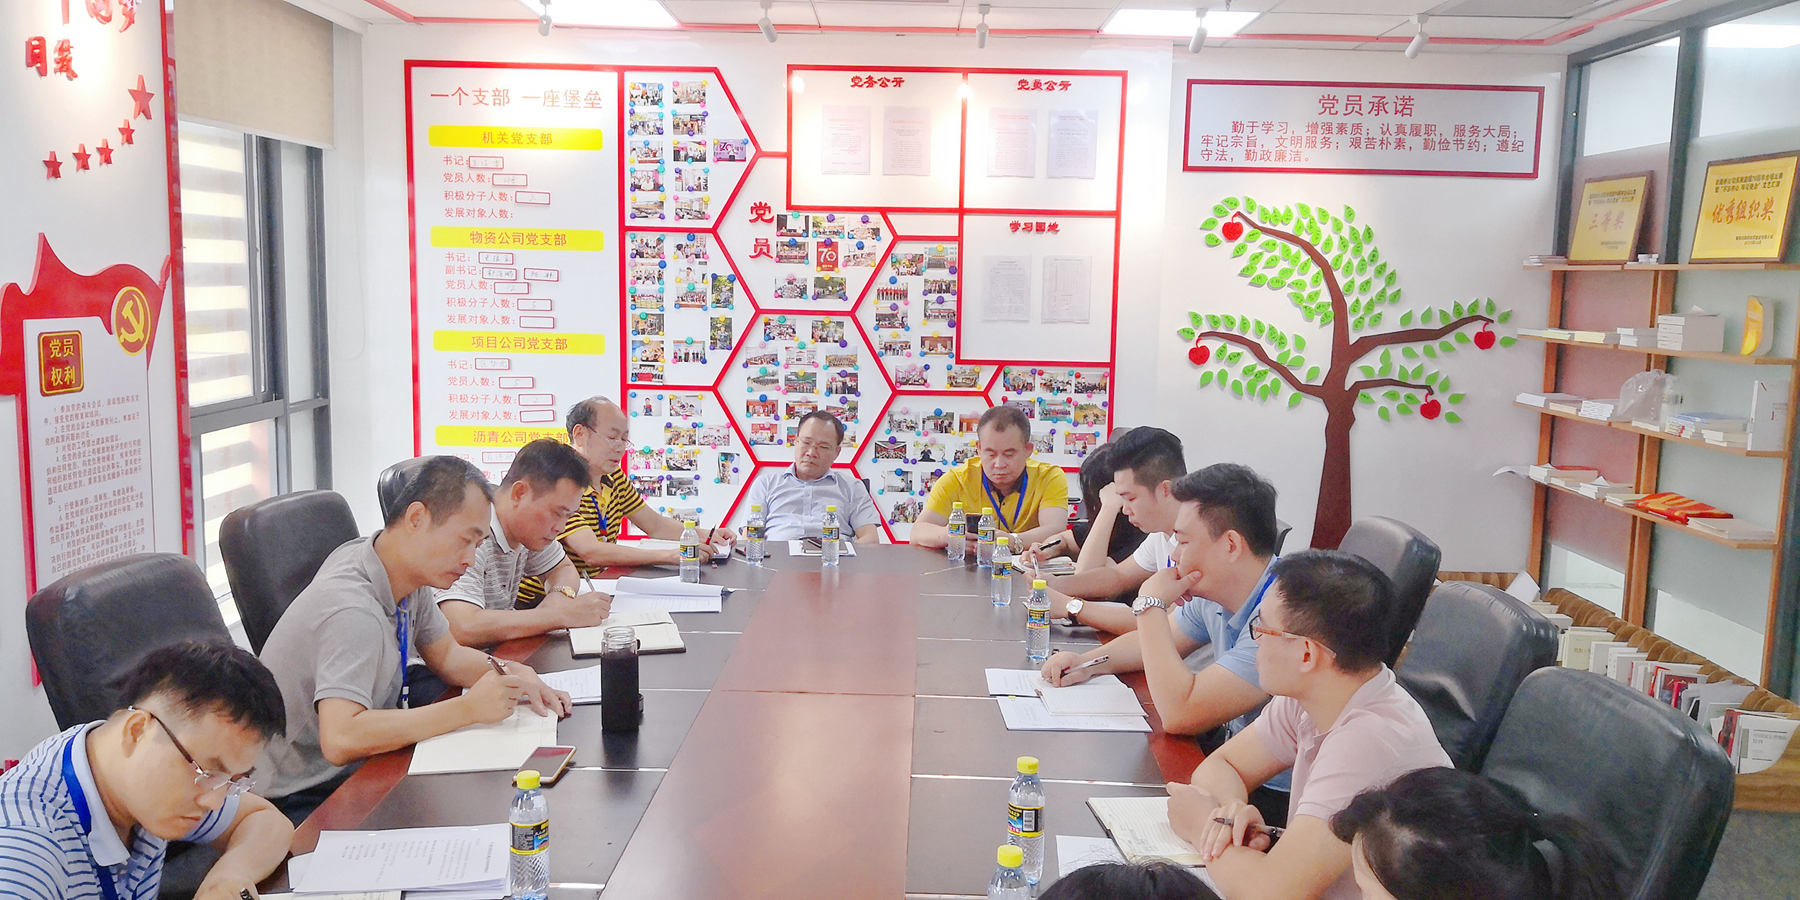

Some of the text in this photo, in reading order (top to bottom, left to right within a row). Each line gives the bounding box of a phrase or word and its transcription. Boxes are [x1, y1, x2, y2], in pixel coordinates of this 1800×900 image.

[850, 74, 905, 88] 党务公开
[1017, 79, 1072, 92] 党员公开
[431, 86, 603, 109] 一个支部 一座堡垒
[1317, 93, 1416, 118] 党员承诺
[481, 131, 553, 146] 机关党支部
[1200, 148, 1312, 163] 守法，勤政廉洁。
[443, 172, 491, 184] 党员人数：
[444, 190, 513, 202] 积极分子人数：
[444, 208, 514, 218] 发展对象人数：
[1712, 196, 1774, 225] 优秀组织奖
[1009, 220, 1060, 234] 学习园地
[1588, 209, 1625, 233] 三等奖
[749, 201, 774, 259] 党员
[470, 231, 568, 246] 物资公司党支部
[446, 280, 492, 290] 党员人数：
[446, 297, 515, 308] 积极分子人数：
[446, 314, 516, 326] 发展对象人数：
[50, 339, 75, 358] 党员
[471, 336, 568, 350] 项目公司党支部
[51, 366, 76, 386] 权利
[448, 376, 494, 386] 党员人数：
[448, 394, 516, 404] 积极分子人数：
[449, 410, 517, 420] 发展对象人数：
